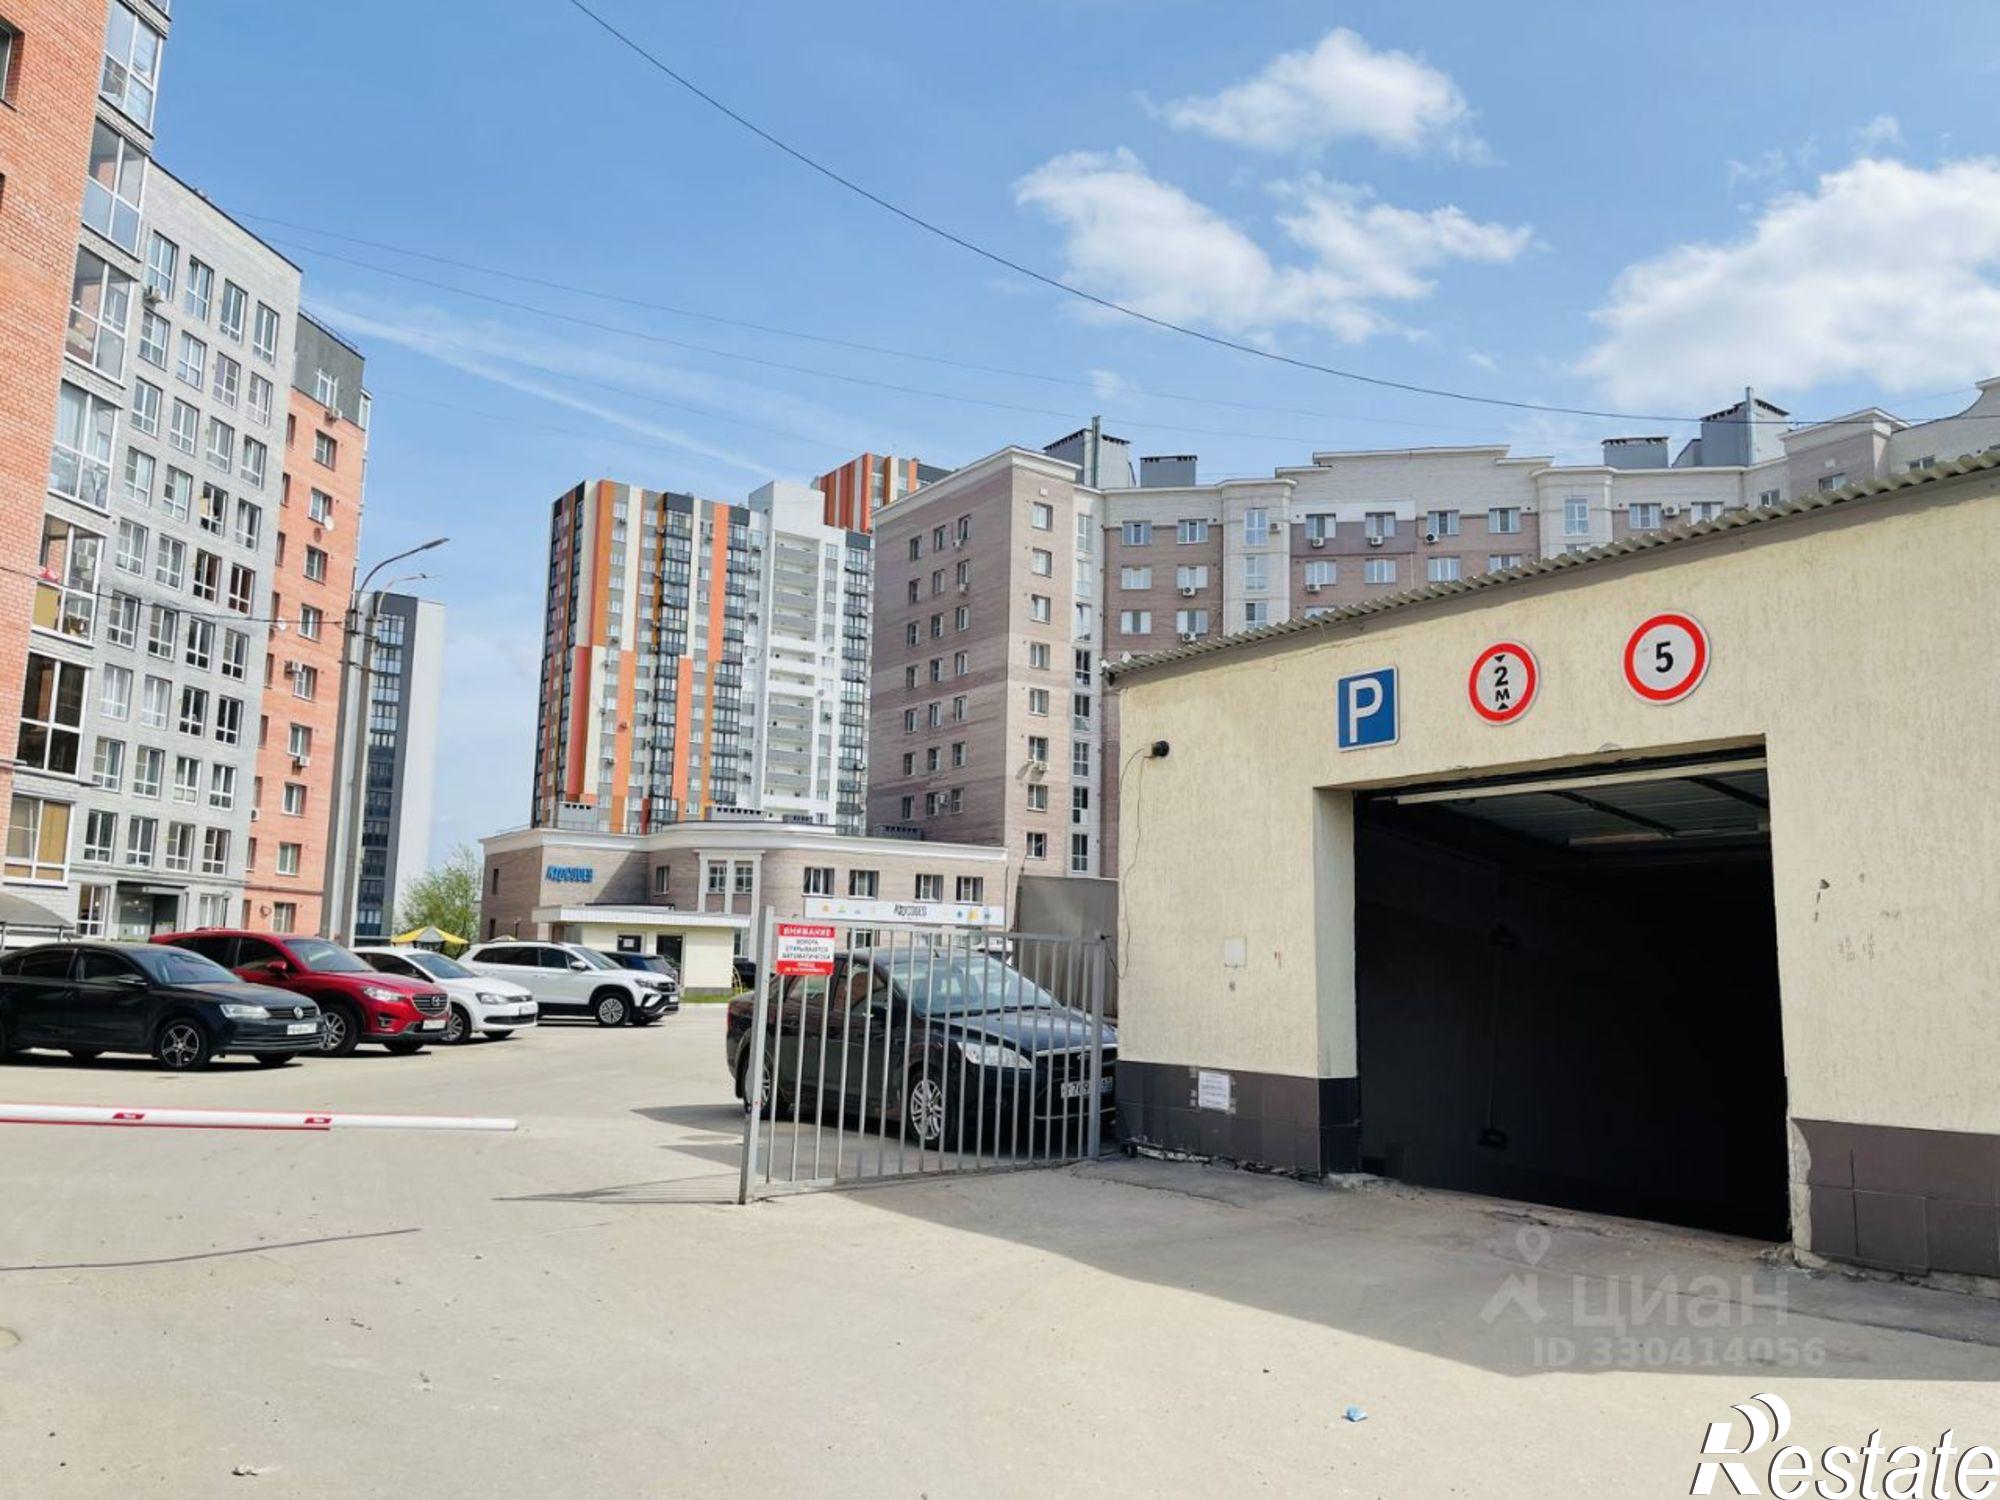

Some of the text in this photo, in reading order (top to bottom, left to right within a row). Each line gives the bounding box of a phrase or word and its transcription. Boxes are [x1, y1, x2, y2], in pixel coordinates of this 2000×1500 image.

[1655, 641, 1674, 674] 5
[1494, 666, 1508, 687] 2
[1349, 677, 1383, 743] P
[783, 927, 830, 937] ВНИМАНИЕ
